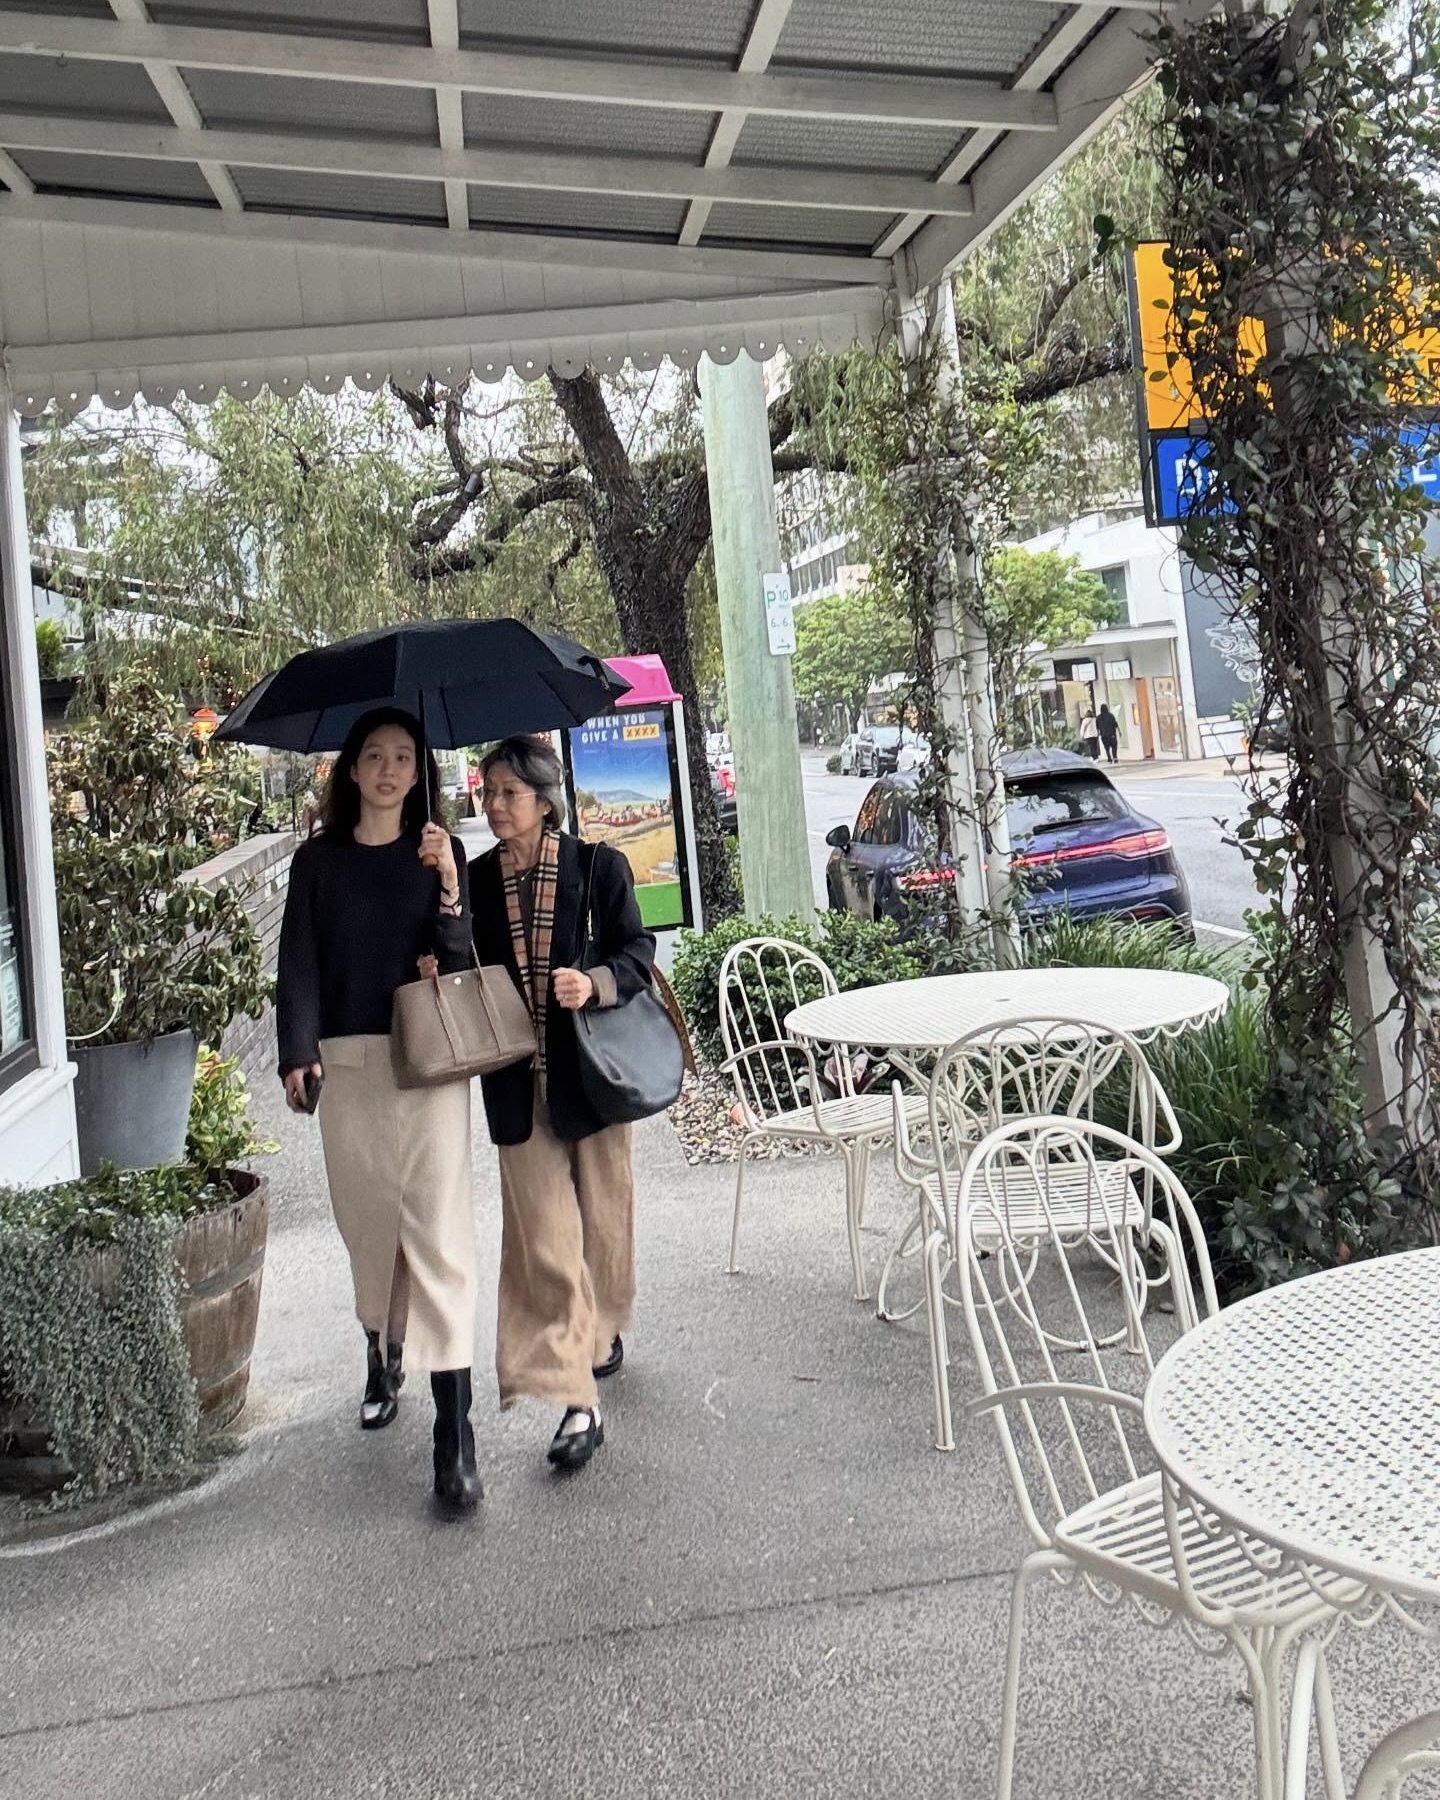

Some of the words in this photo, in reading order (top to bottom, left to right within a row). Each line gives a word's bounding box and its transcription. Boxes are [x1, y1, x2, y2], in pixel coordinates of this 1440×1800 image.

[586, 716, 620, 729] WHEN
[623, 714, 645, 726] YOU
[581, 731, 608, 744] GIVE
[612, 729, 619, 740] A
[626, 727, 657, 738] XXXX
